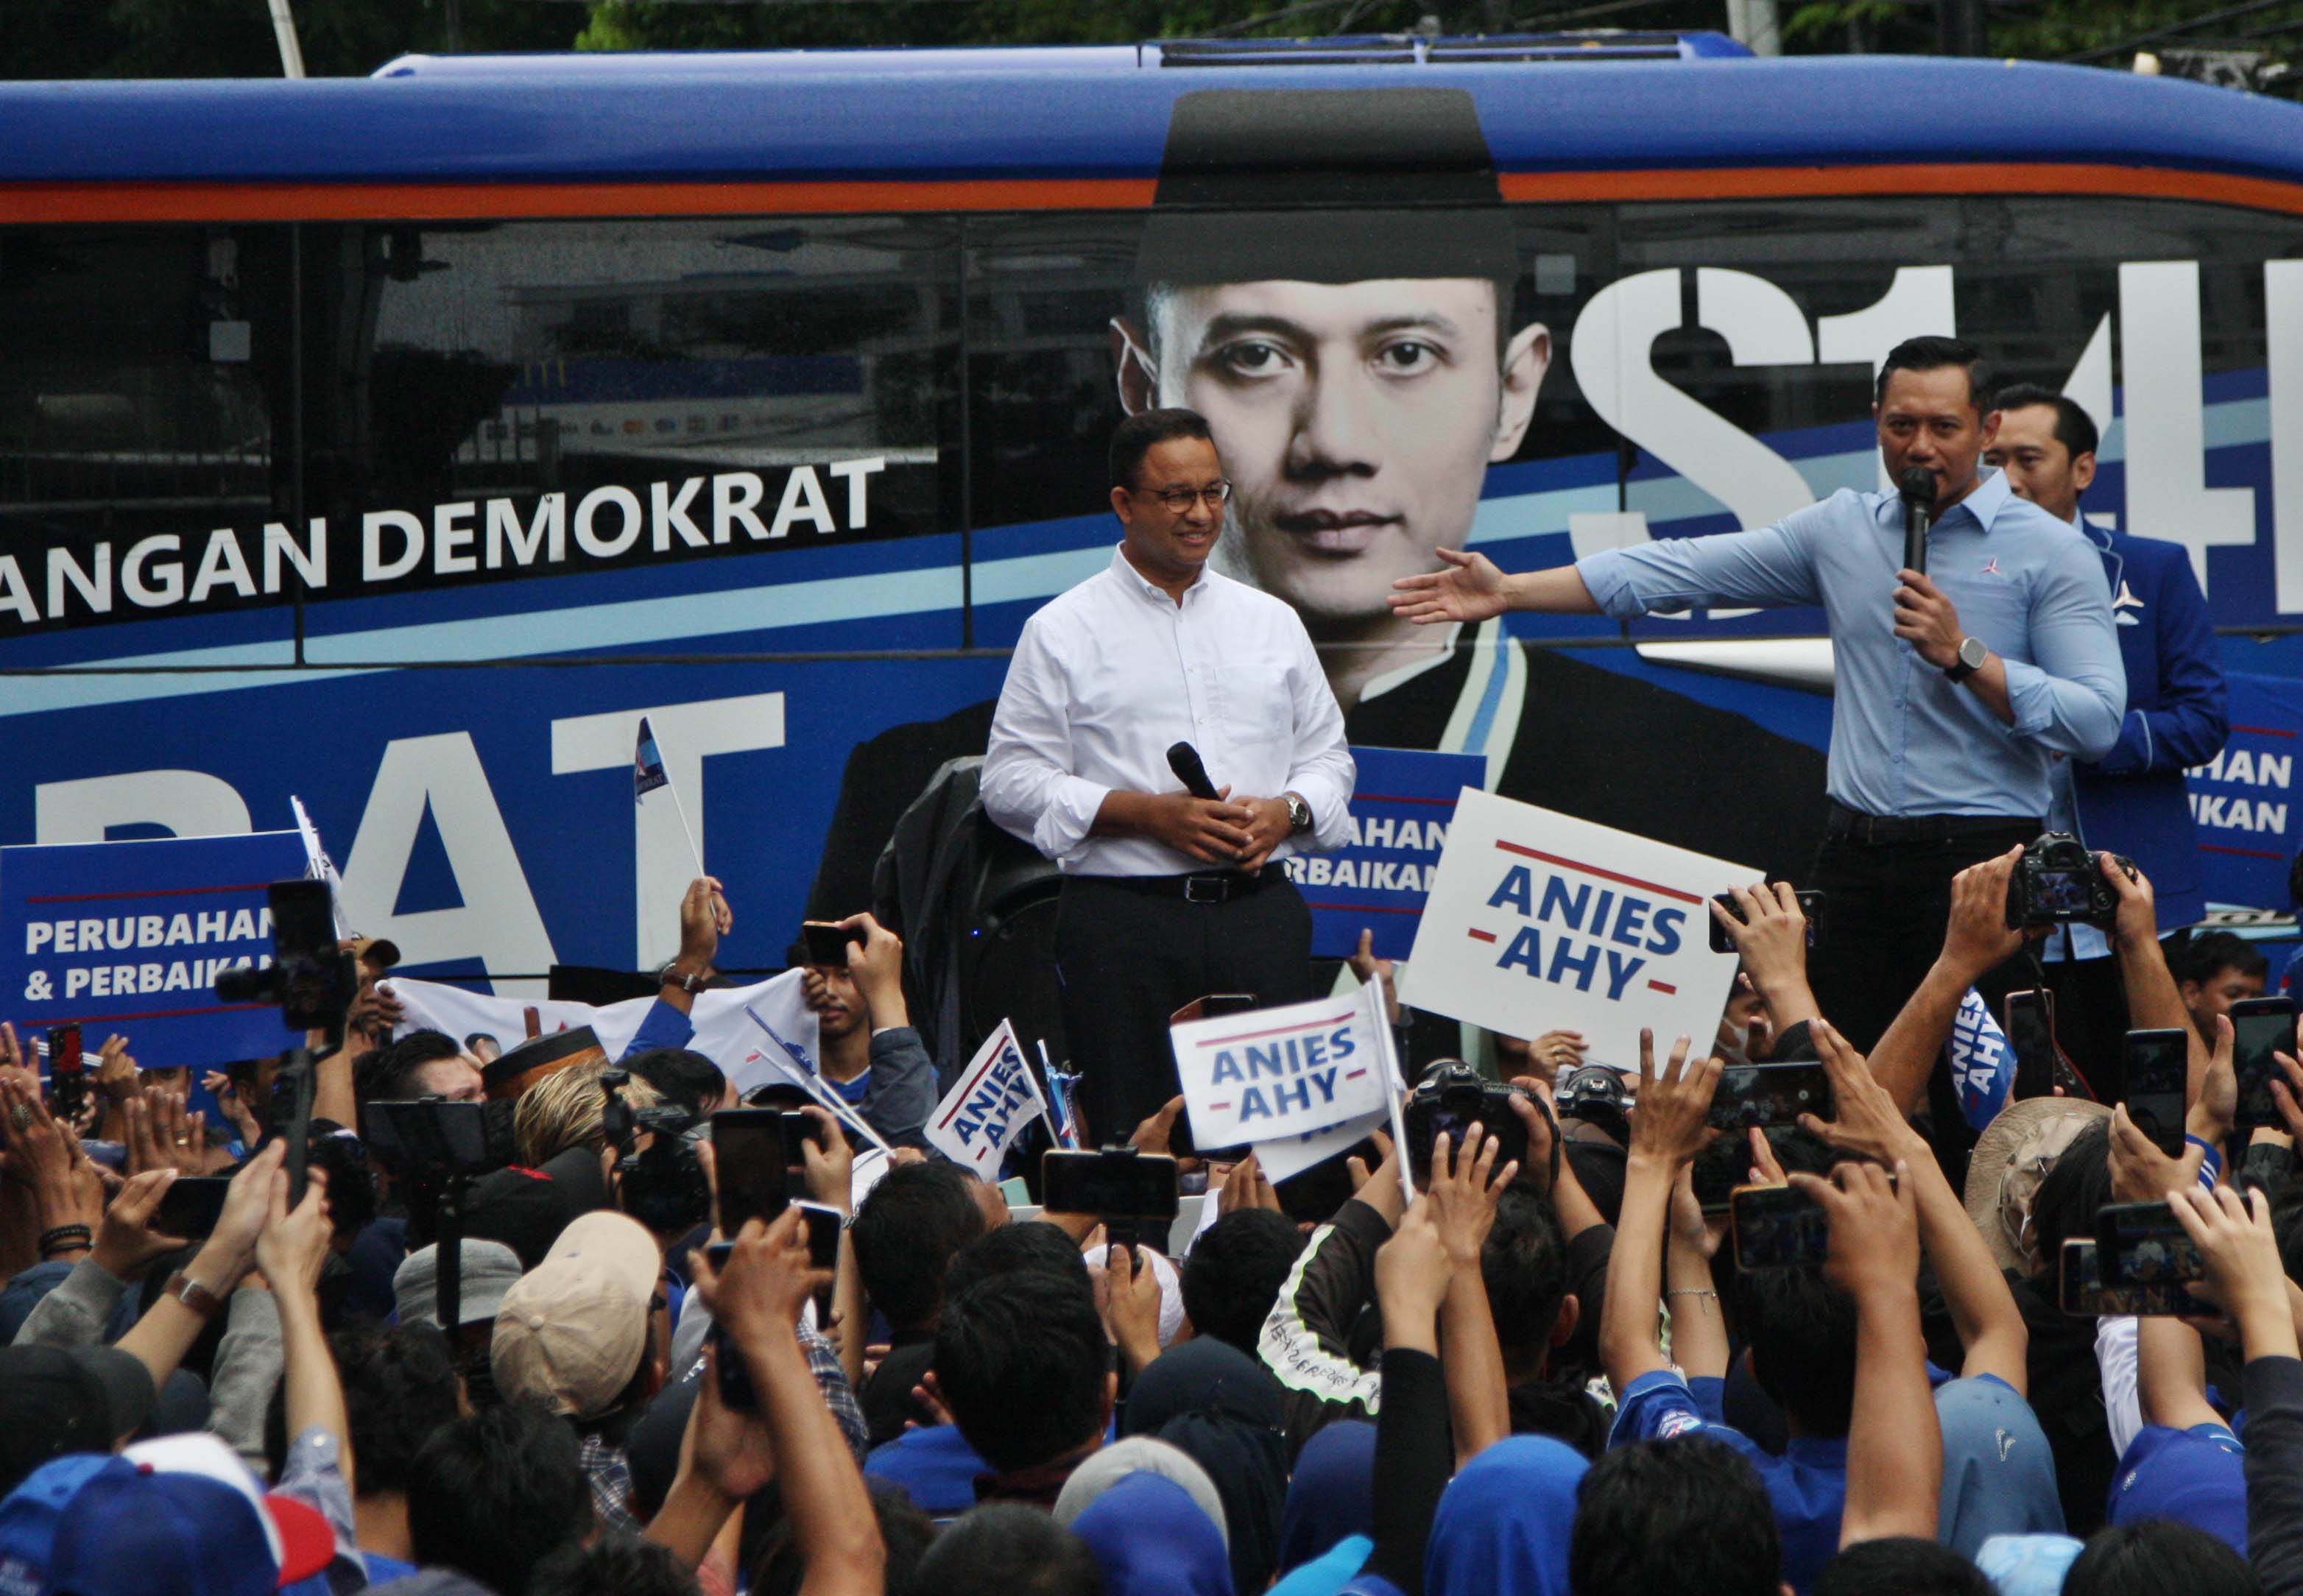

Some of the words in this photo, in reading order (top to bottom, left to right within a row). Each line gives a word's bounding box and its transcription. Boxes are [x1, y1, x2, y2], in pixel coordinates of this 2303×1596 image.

[363, 456, 886, 582] DEMOKRAT
[2182, 749, 2293, 788] HAN
[1487, 864, 1687, 956] ANIES
[24, 970, 53, 1001] &
[1495, 925, 1647, 1002] AHY
[1211, 1026, 1356, 1085] ANIES
[1952, 992, 1985, 1099] ANIES
[1968, 1011, 2005, 1095] AHY
[953, 1046, 1023, 1146] ANIES
[984, 1074, 1034, 1150] AHY
[1238, 1067, 1339, 1123] AHY
